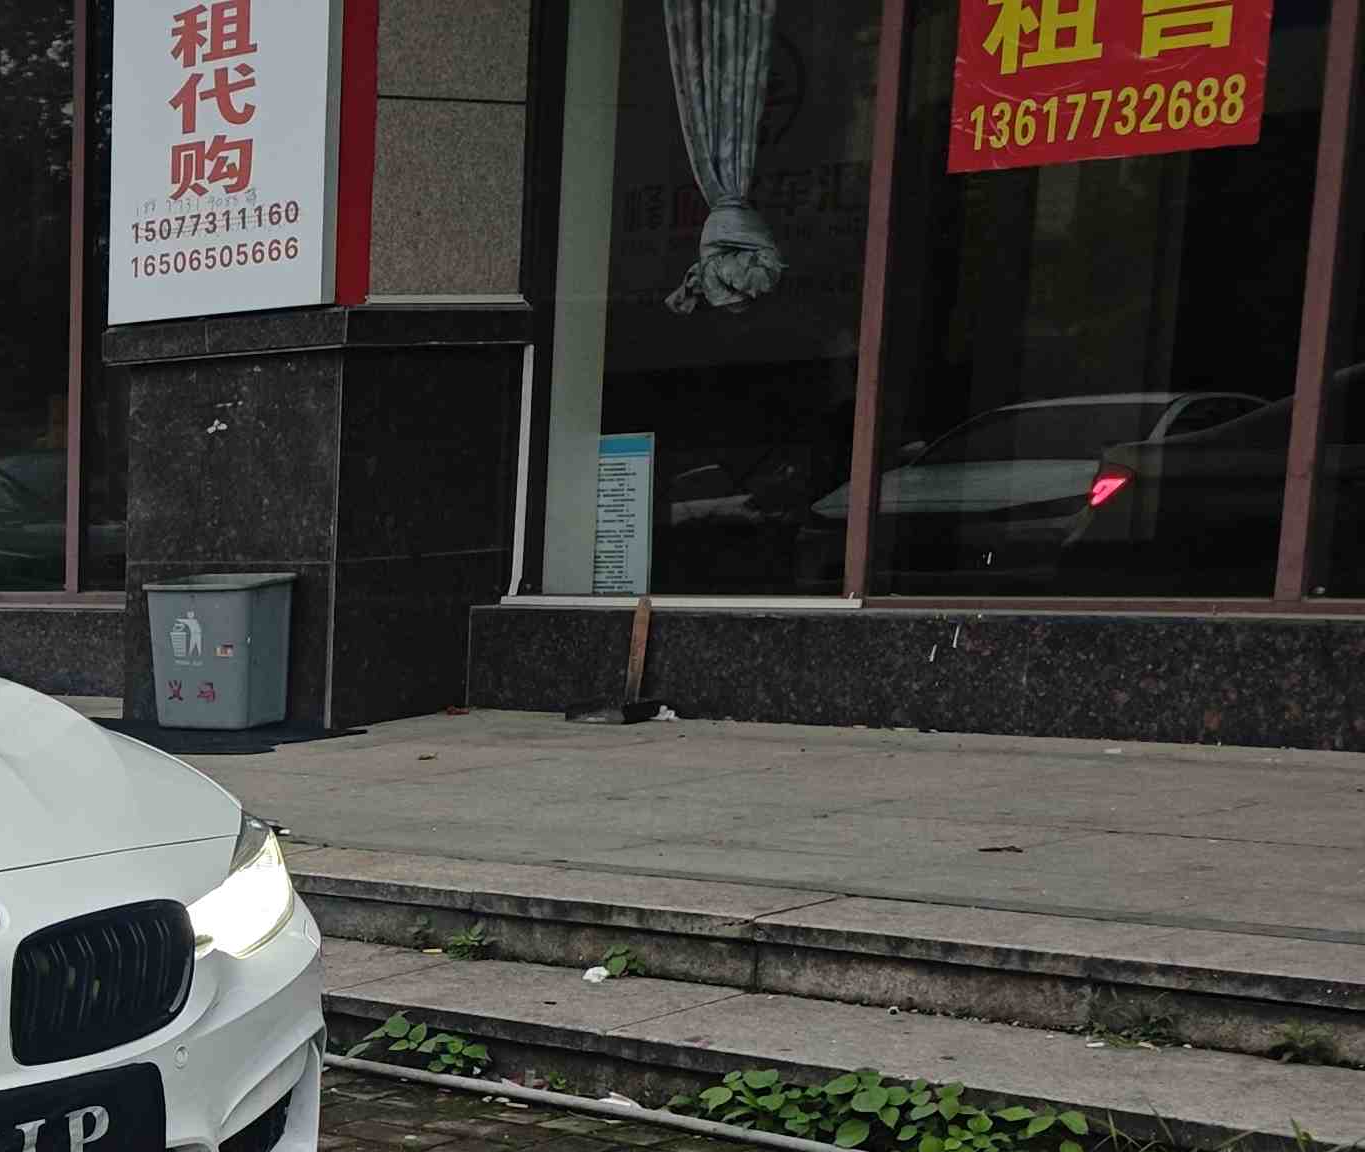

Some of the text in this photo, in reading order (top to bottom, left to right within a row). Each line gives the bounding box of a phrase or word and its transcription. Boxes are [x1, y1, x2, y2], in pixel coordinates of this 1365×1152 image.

[969, 73, 1247, 151] 13617732688
[132, 200, 299, 244] 15077311160
[131, 236, 299, 278] 16506505666
